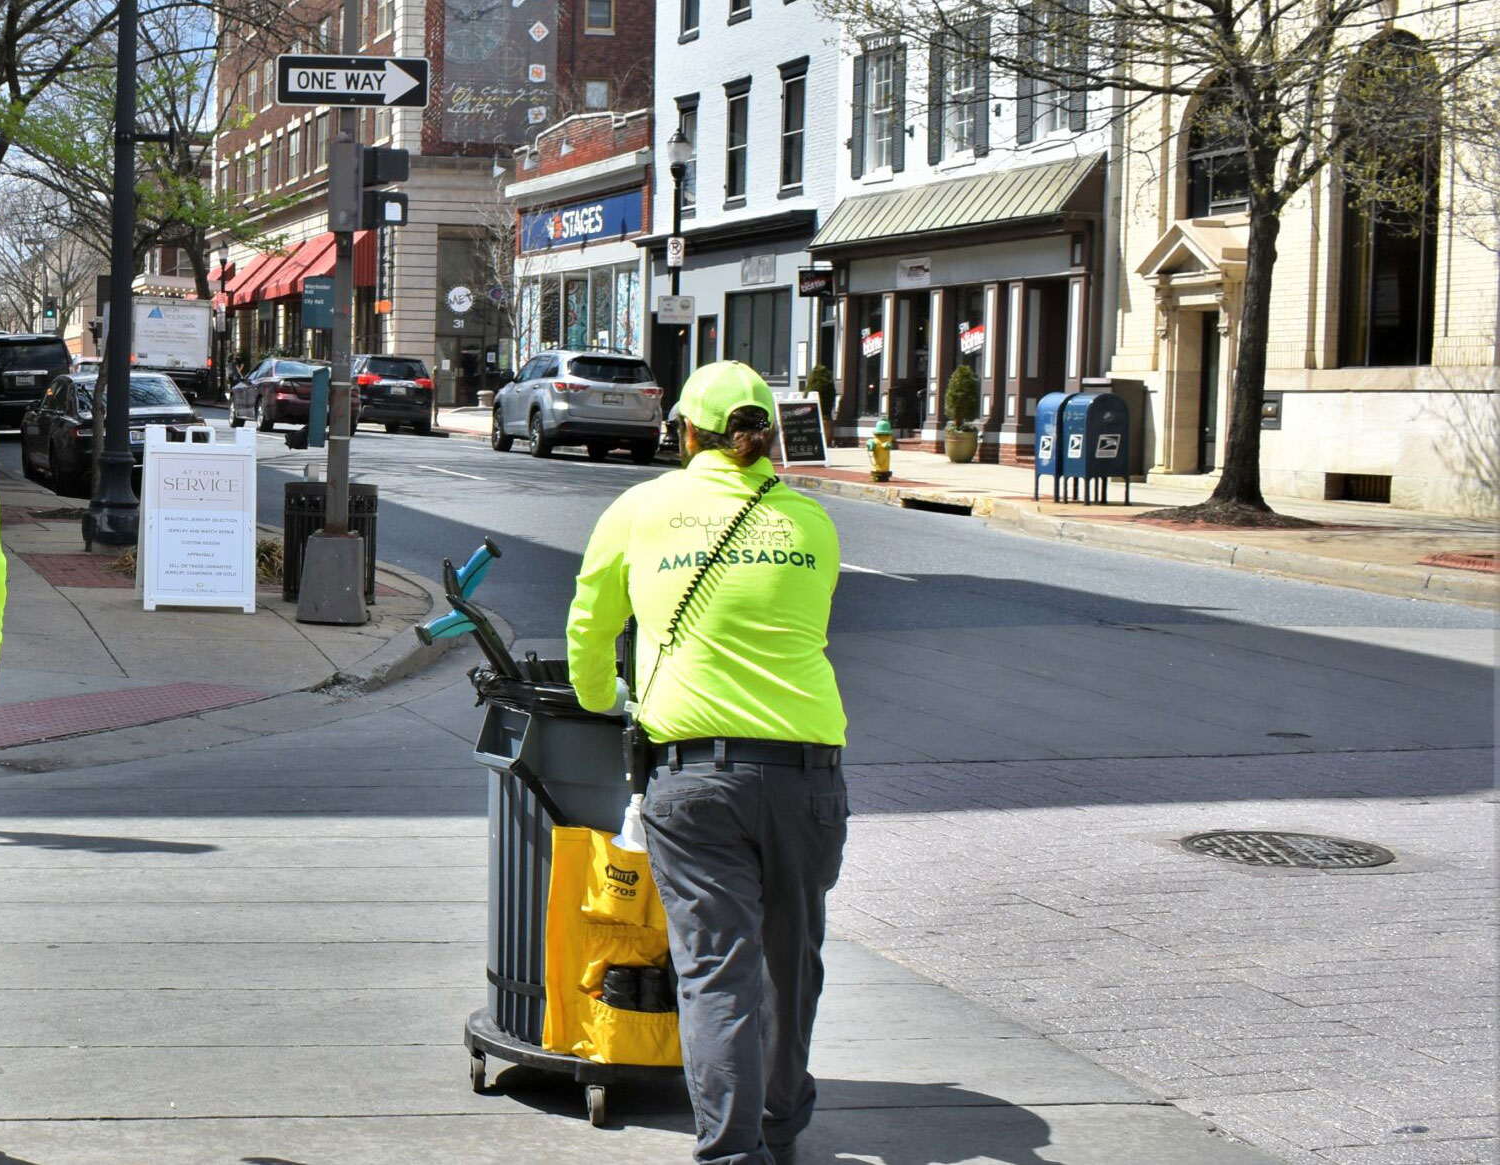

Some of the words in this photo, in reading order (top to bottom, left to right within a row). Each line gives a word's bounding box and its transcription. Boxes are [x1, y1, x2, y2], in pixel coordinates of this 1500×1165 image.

[297, 71, 337, 90] ONE
[345, 72, 387, 91] WAY
[561, 204, 603, 239] STAGES
[452, 319, 465, 328] 31
[163, 477, 240, 492] SERVICE
[607, 866, 636, 884] WHITE
